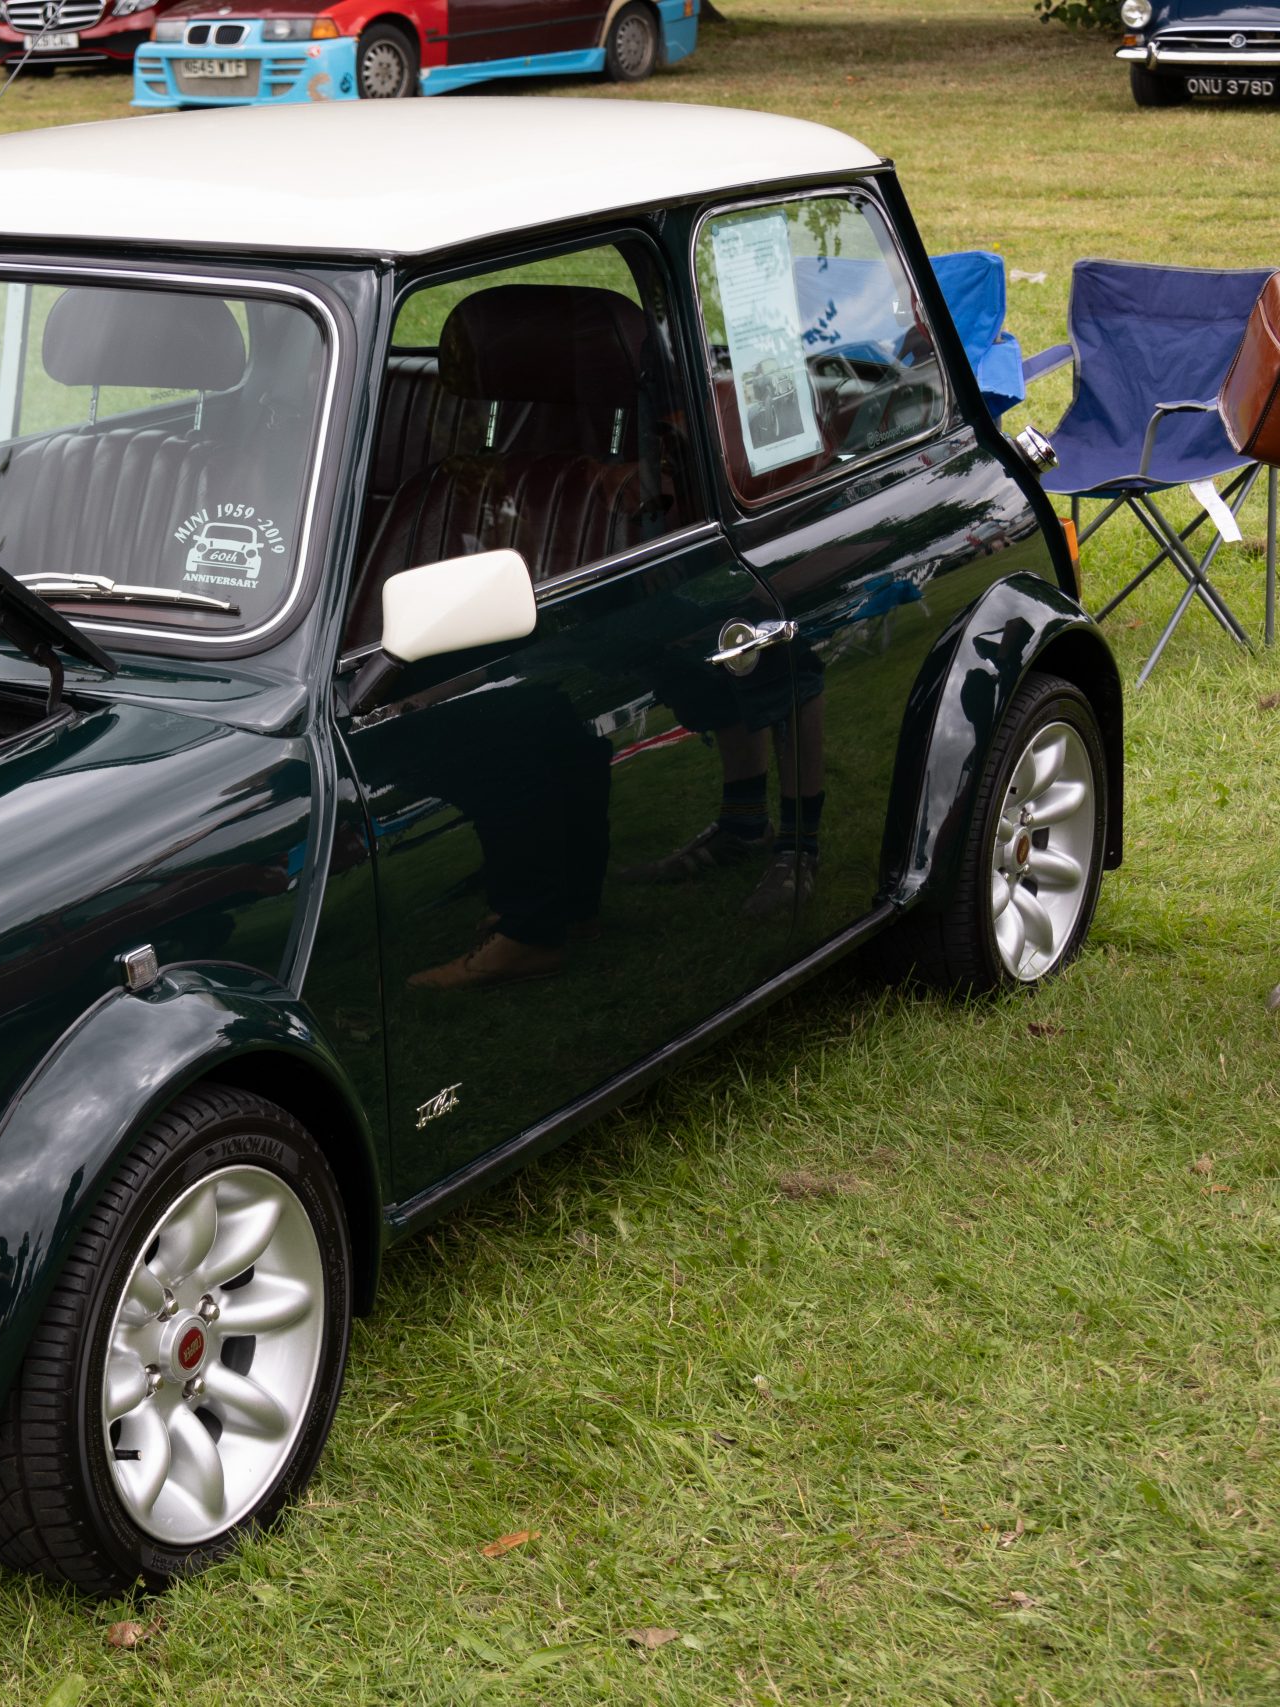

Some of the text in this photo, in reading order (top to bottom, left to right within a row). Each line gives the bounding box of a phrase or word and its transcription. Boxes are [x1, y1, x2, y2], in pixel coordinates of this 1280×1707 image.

[1187, 79, 1274, 96] ONU 378D
[174, 508, 209, 543] MINI
[217, 503, 255, 519] 1959
[210, 549, 238, 563] 60th
[182, 572, 260, 589] ANNIVERSARY
[221, 1136, 285, 1160] YOKOHAMA
